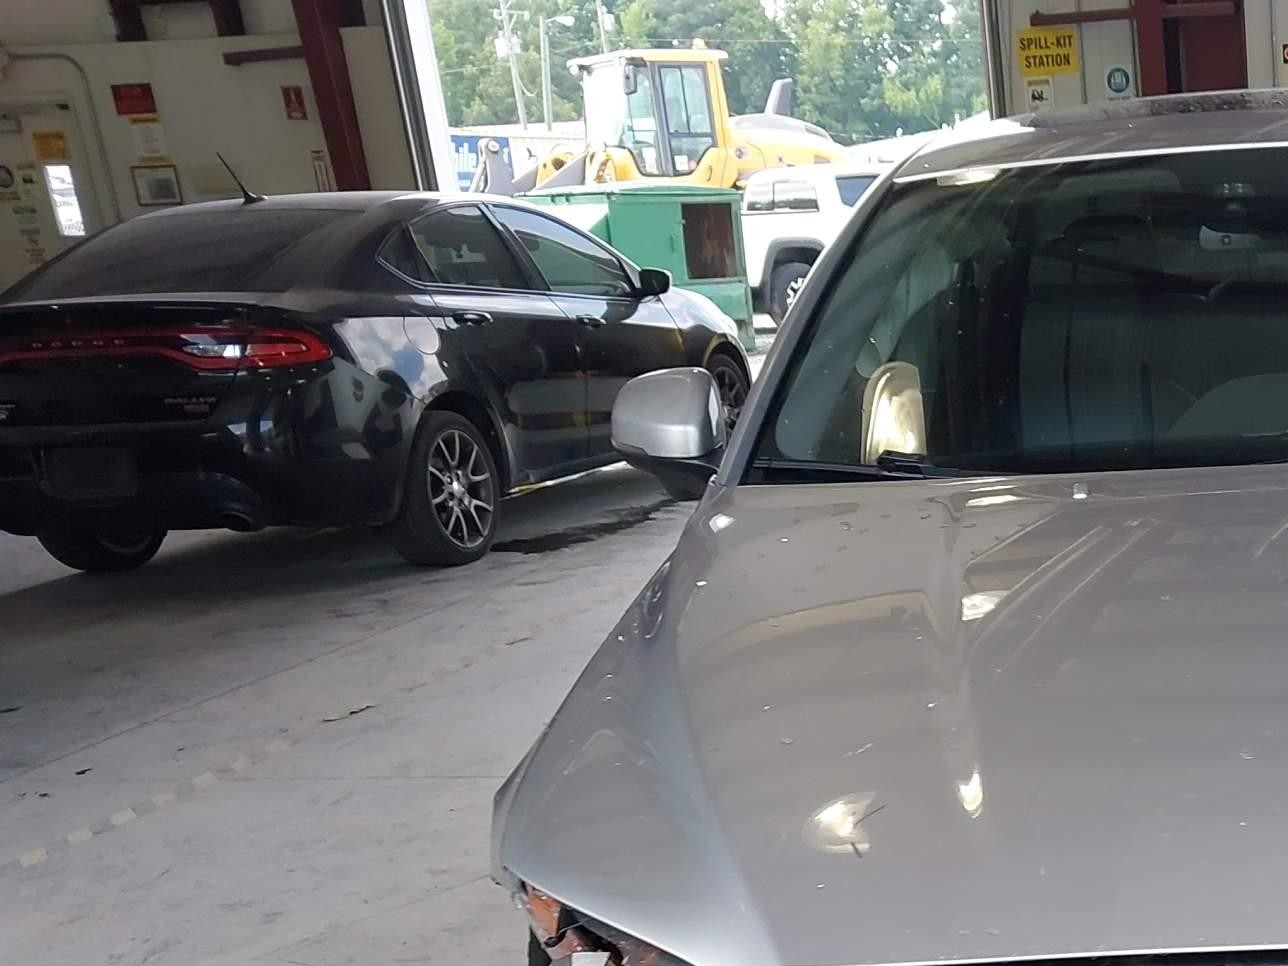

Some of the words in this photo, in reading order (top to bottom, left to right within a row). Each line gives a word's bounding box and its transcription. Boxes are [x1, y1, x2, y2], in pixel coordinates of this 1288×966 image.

[1019, 34, 1074, 51] SPILL-KIT
[1025, 53, 1071, 69] STATION
[32, 338, 125, 349] DODGE
